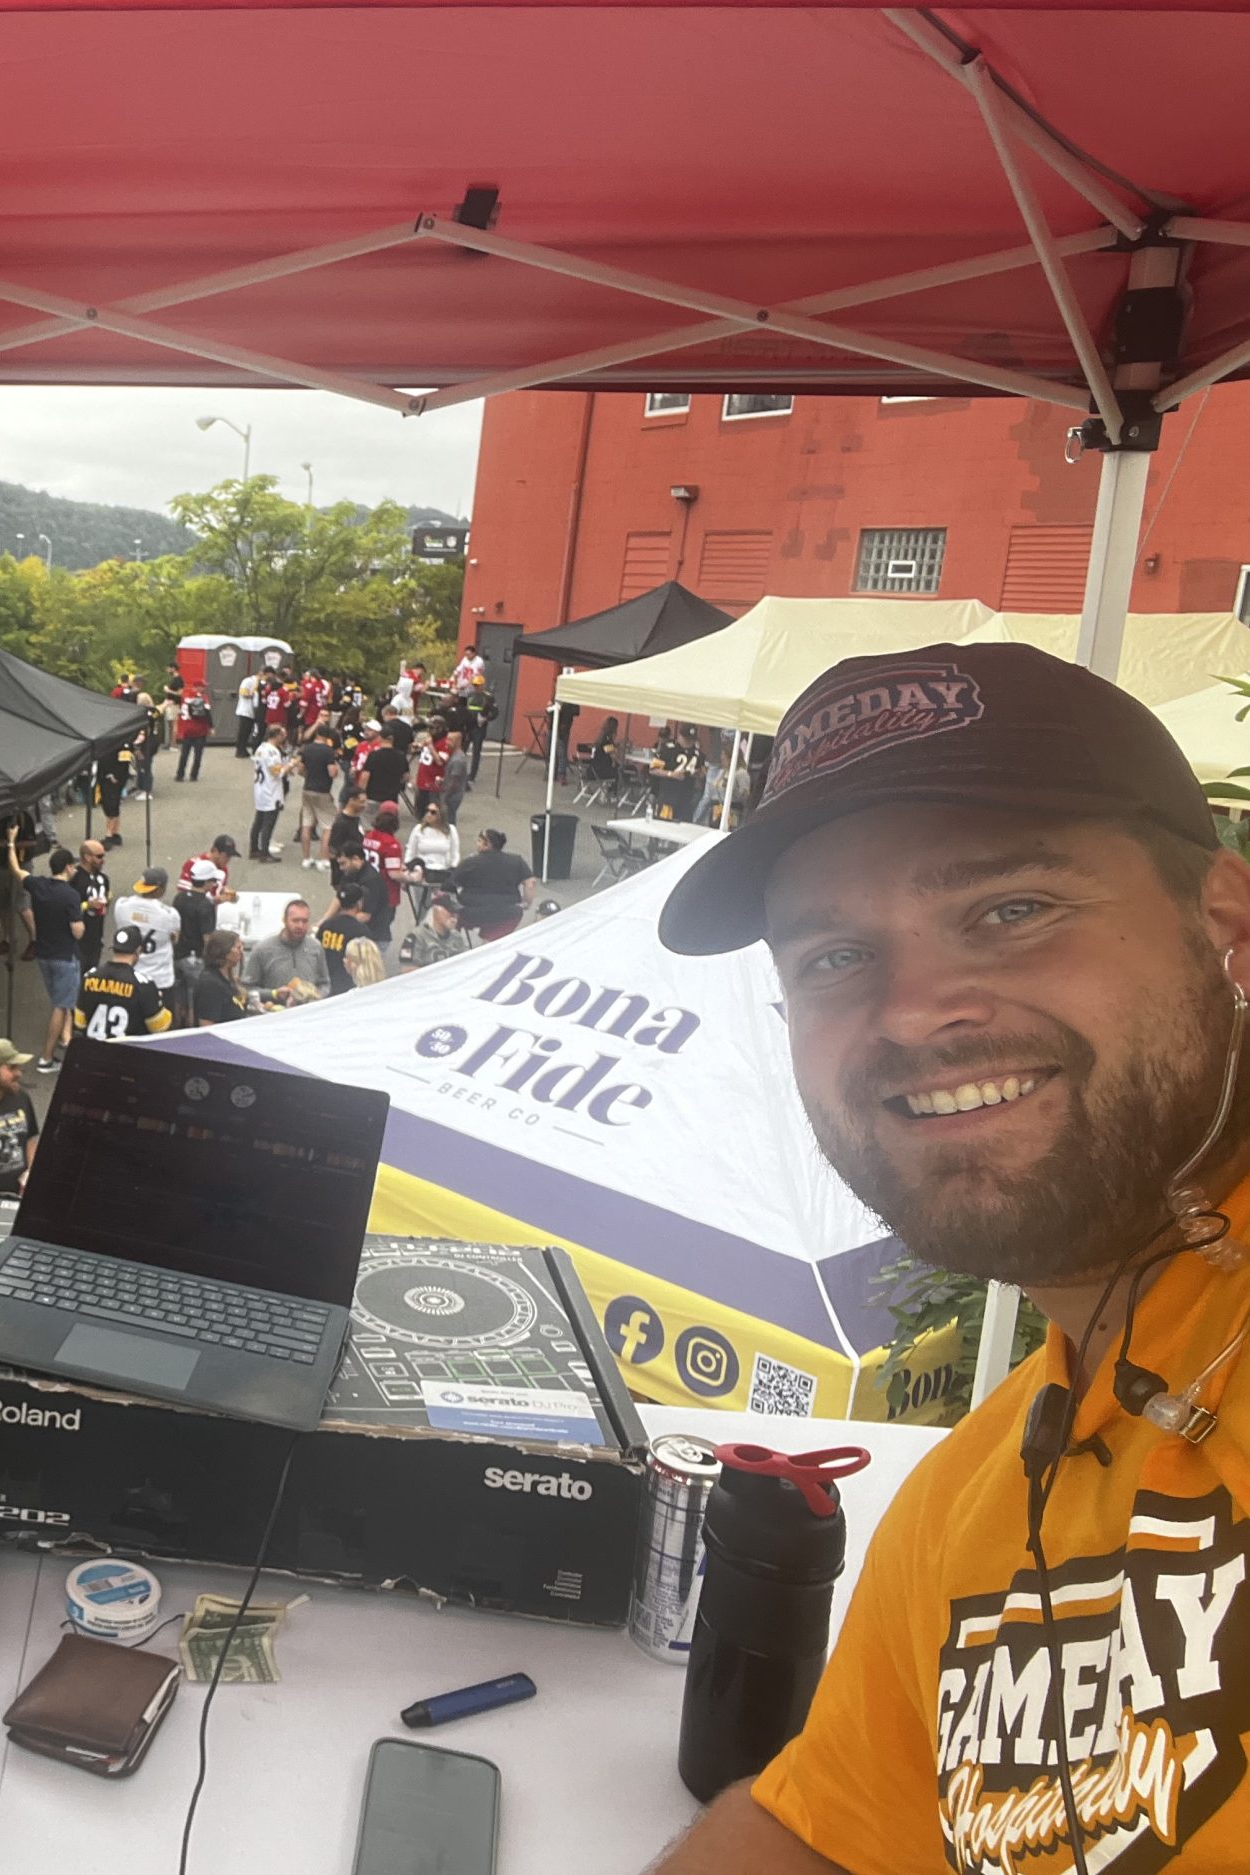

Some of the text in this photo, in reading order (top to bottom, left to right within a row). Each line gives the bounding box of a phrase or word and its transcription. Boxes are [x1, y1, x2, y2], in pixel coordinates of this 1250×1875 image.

[767, 681, 968, 782] AMEDAY
[87, 1003, 129, 1040] 43
[471, 951, 701, 1054] Bona
[449, 1023, 653, 1126] Fide
[437, 1082, 541, 1126] BEER CO
[466, 1395, 530, 1408] serato
[483, 1466, 593, 1501] serato
